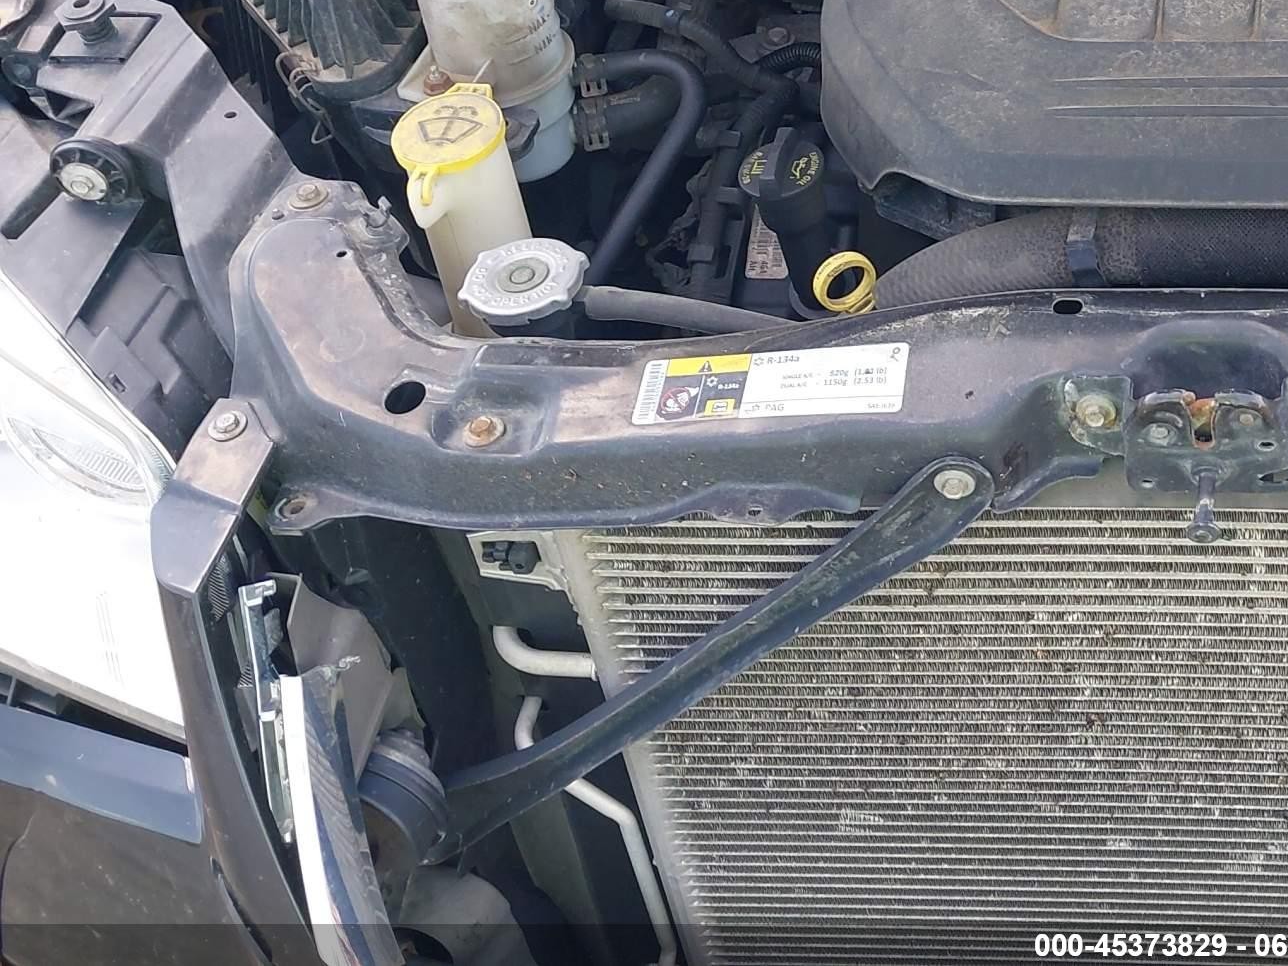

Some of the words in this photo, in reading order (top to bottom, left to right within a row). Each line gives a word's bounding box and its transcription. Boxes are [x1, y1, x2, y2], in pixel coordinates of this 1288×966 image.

[807, 152, 820, 175] ENGINE
[796, 175, 811, 186] OIL
[767, 355, 800, 364] R-134a
[765, 403, 785, 411] PAG
